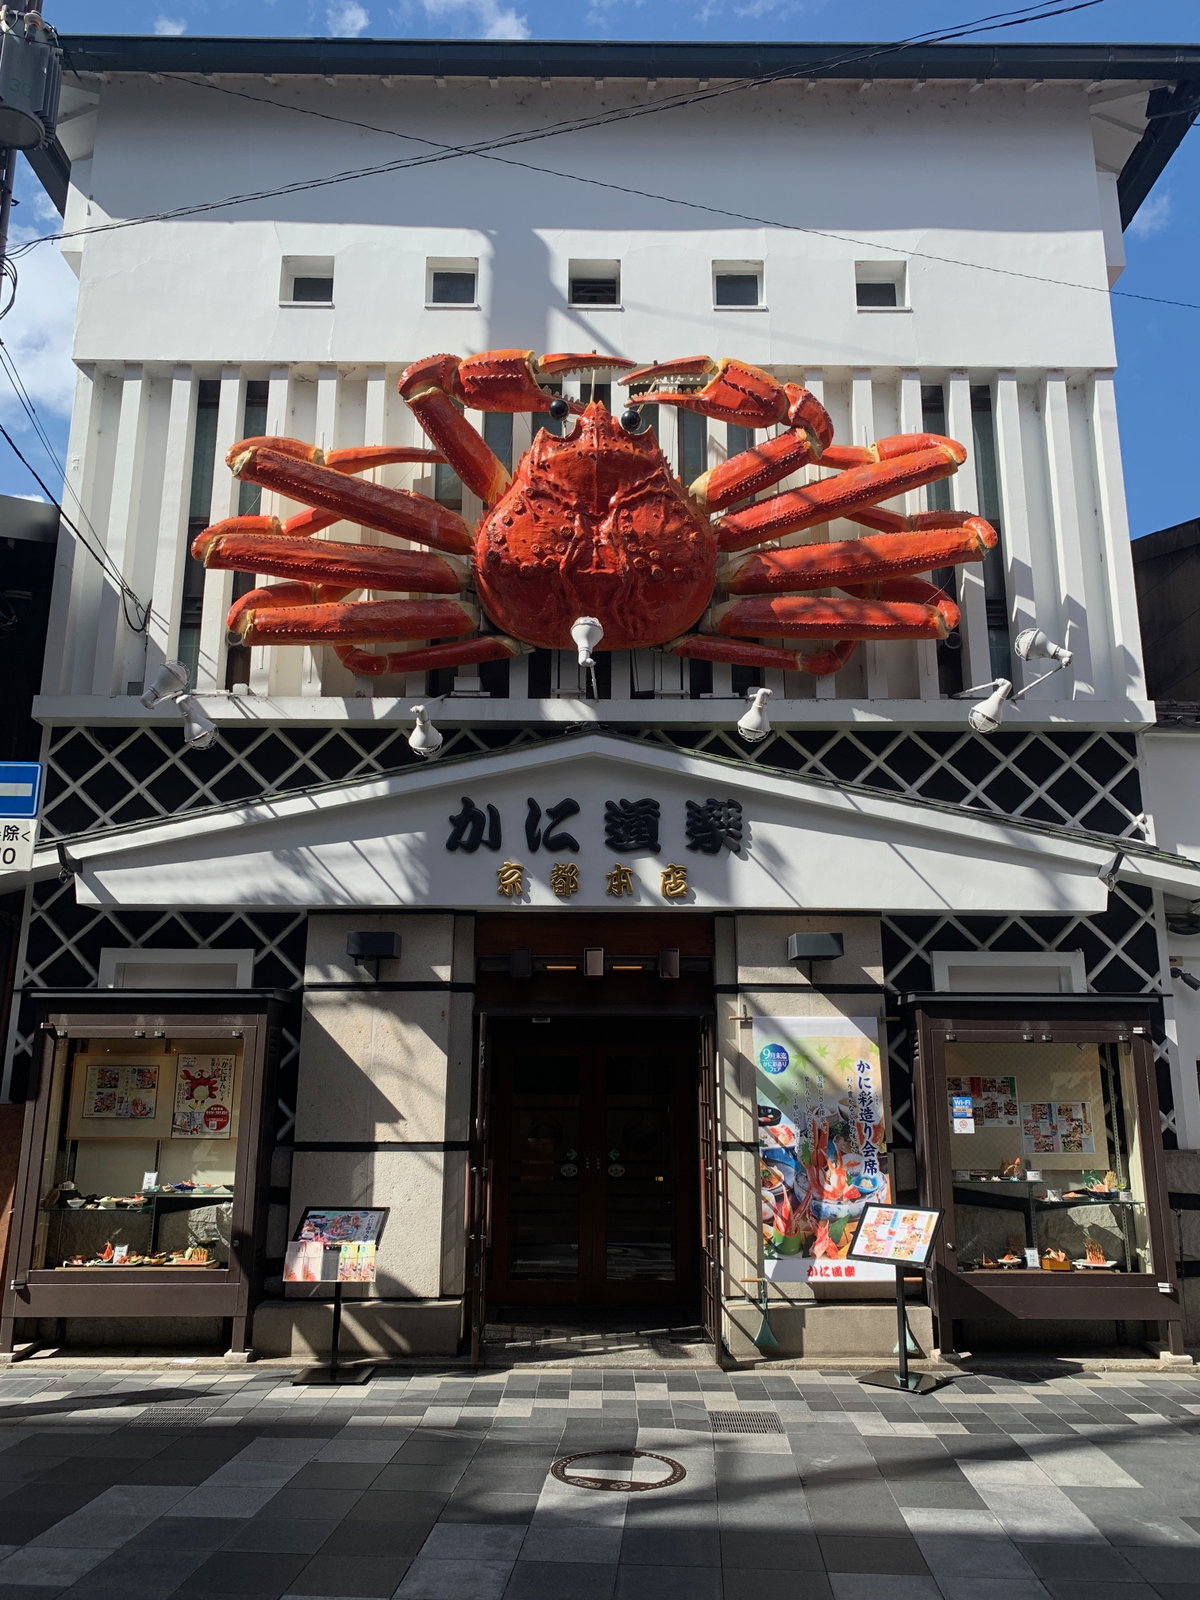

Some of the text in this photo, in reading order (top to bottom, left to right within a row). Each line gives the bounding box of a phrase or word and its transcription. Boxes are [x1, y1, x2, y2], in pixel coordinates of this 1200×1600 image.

[0, 824, 31, 842] 除く
[496, 861, 689, 897] 京都本店
[856, 1060, 878, 1176] かに彩造り会席
